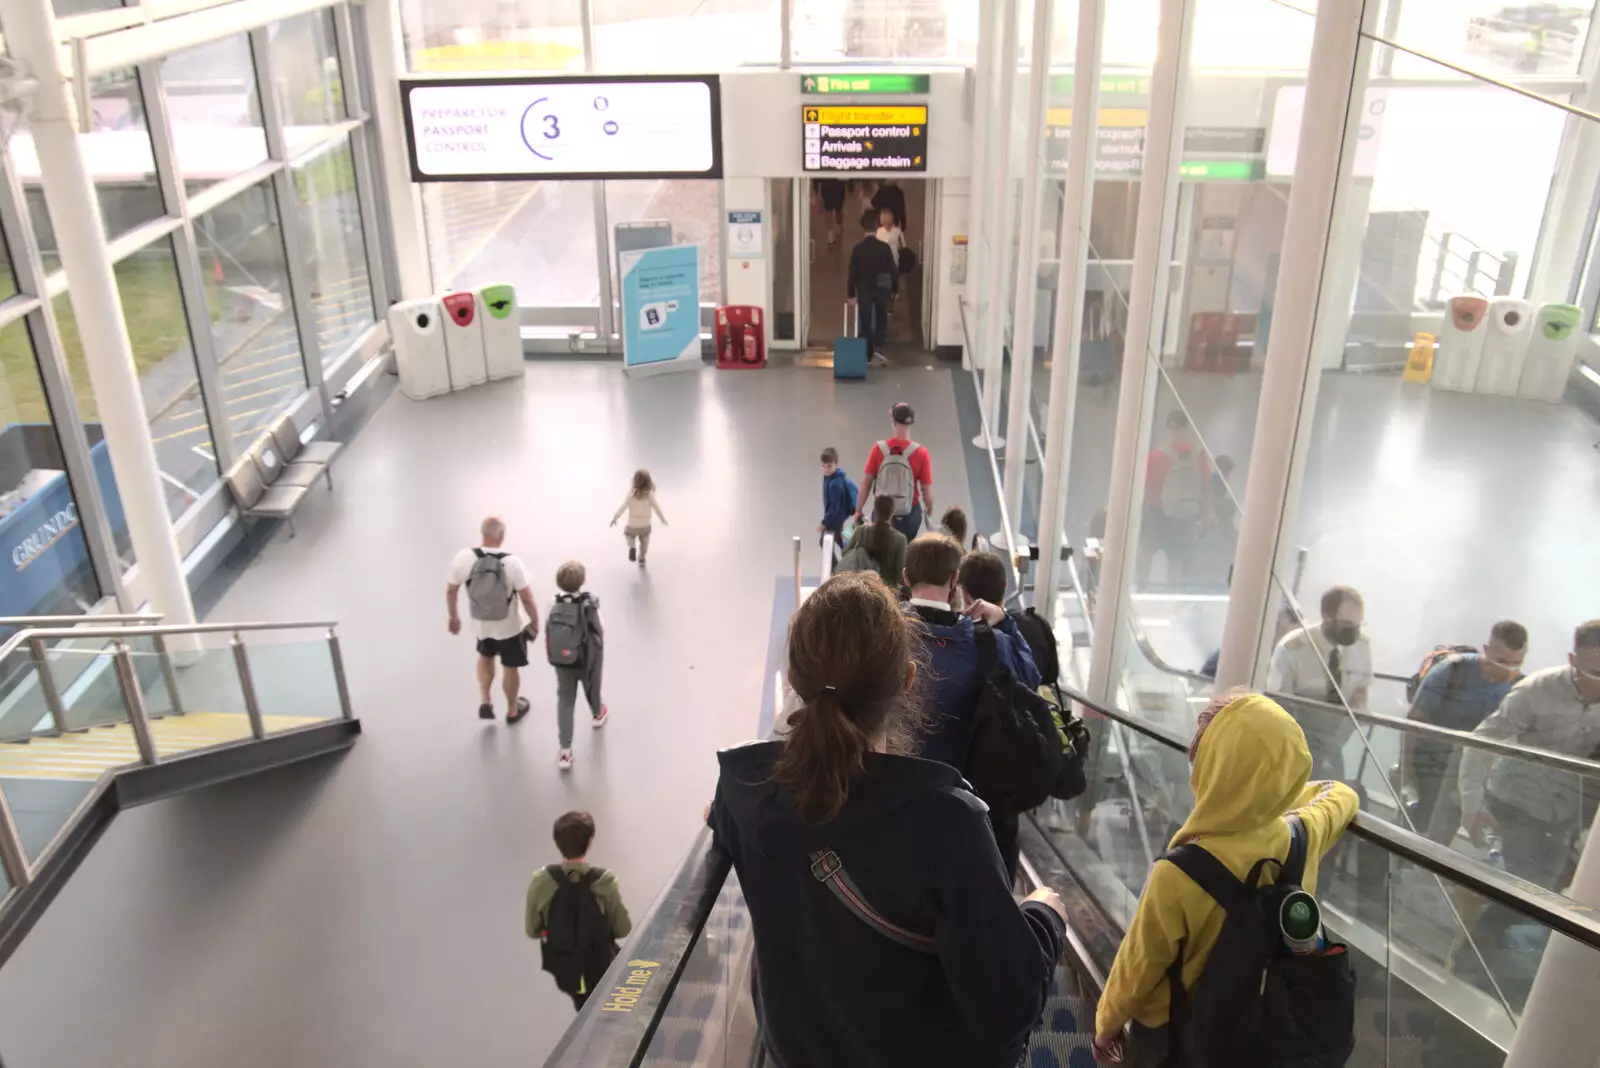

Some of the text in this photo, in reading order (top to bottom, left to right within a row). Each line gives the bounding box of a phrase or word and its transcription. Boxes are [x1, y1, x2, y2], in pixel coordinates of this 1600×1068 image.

[421, 107, 507, 119] PREPARE FOR
[422, 124, 488, 135] PASSPORT
[542, 114, 561, 139] 3
[821, 126, 910, 138] Passport control
[424, 141, 487, 153] CONTROL
[822, 141, 862, 152] Arrivals
[821, 156, 910, 169] Baggage reclaim
[601, 969, 653, 1013] Hold me
